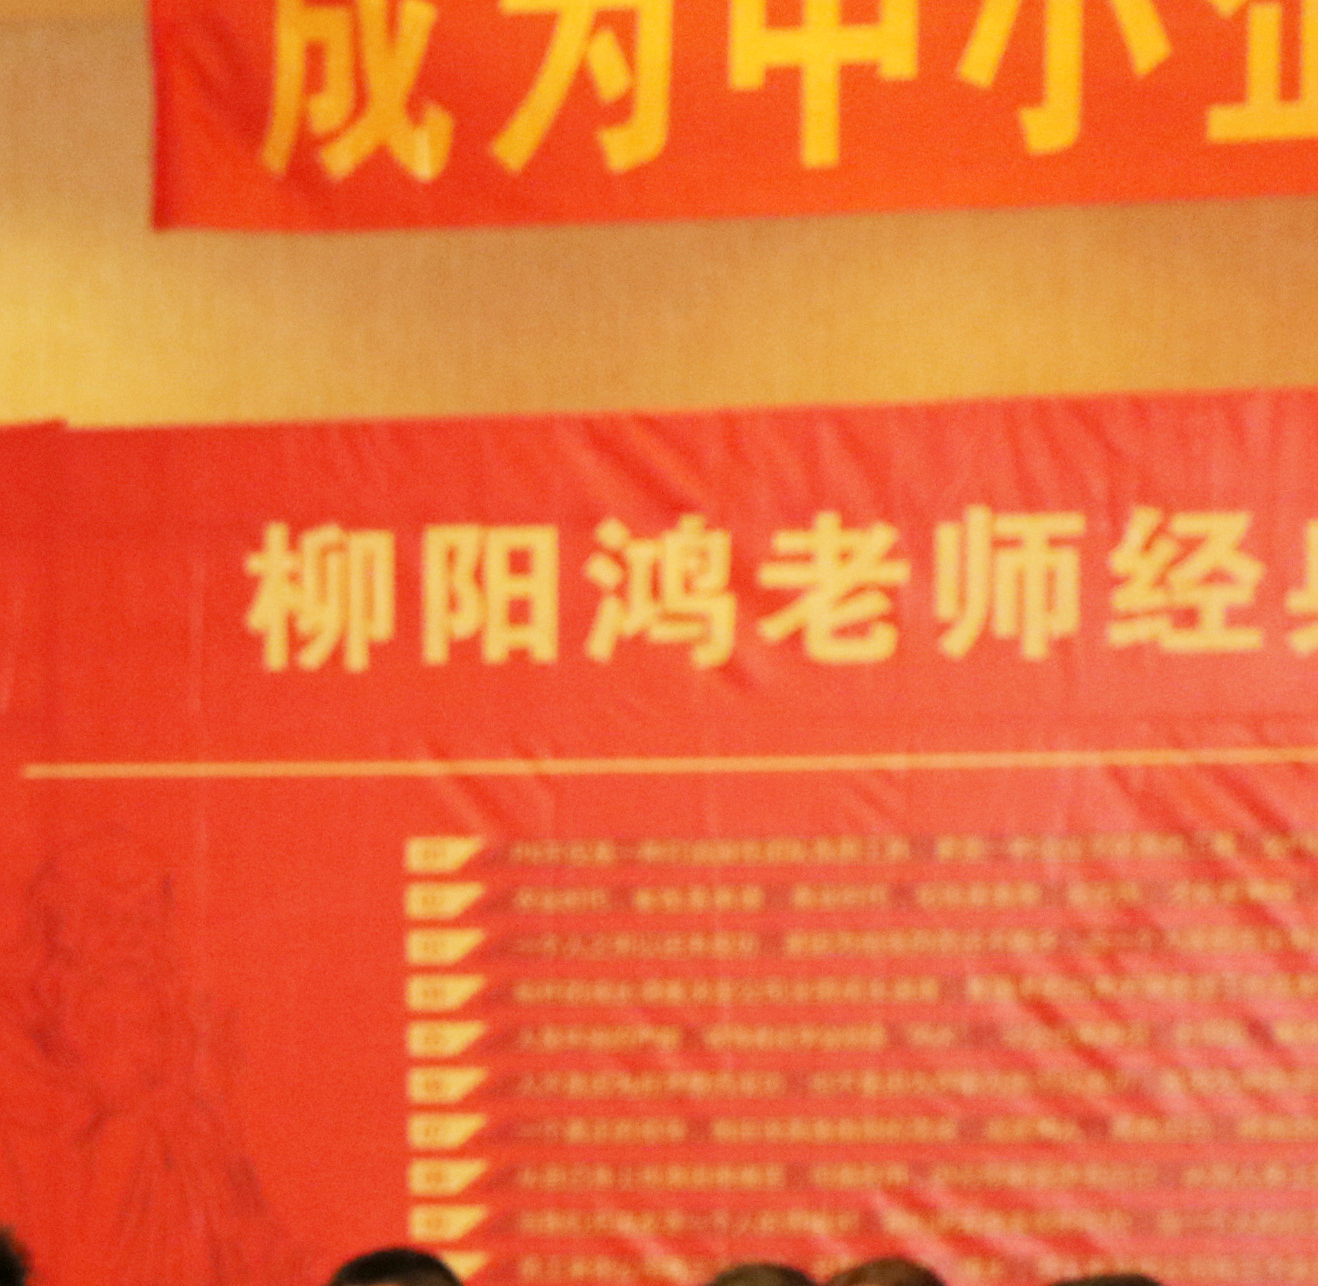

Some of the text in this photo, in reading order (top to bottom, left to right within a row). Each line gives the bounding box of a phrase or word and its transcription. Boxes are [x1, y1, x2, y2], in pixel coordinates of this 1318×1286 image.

[244, 504, 1318, 672] 柳阳鸿老师经
